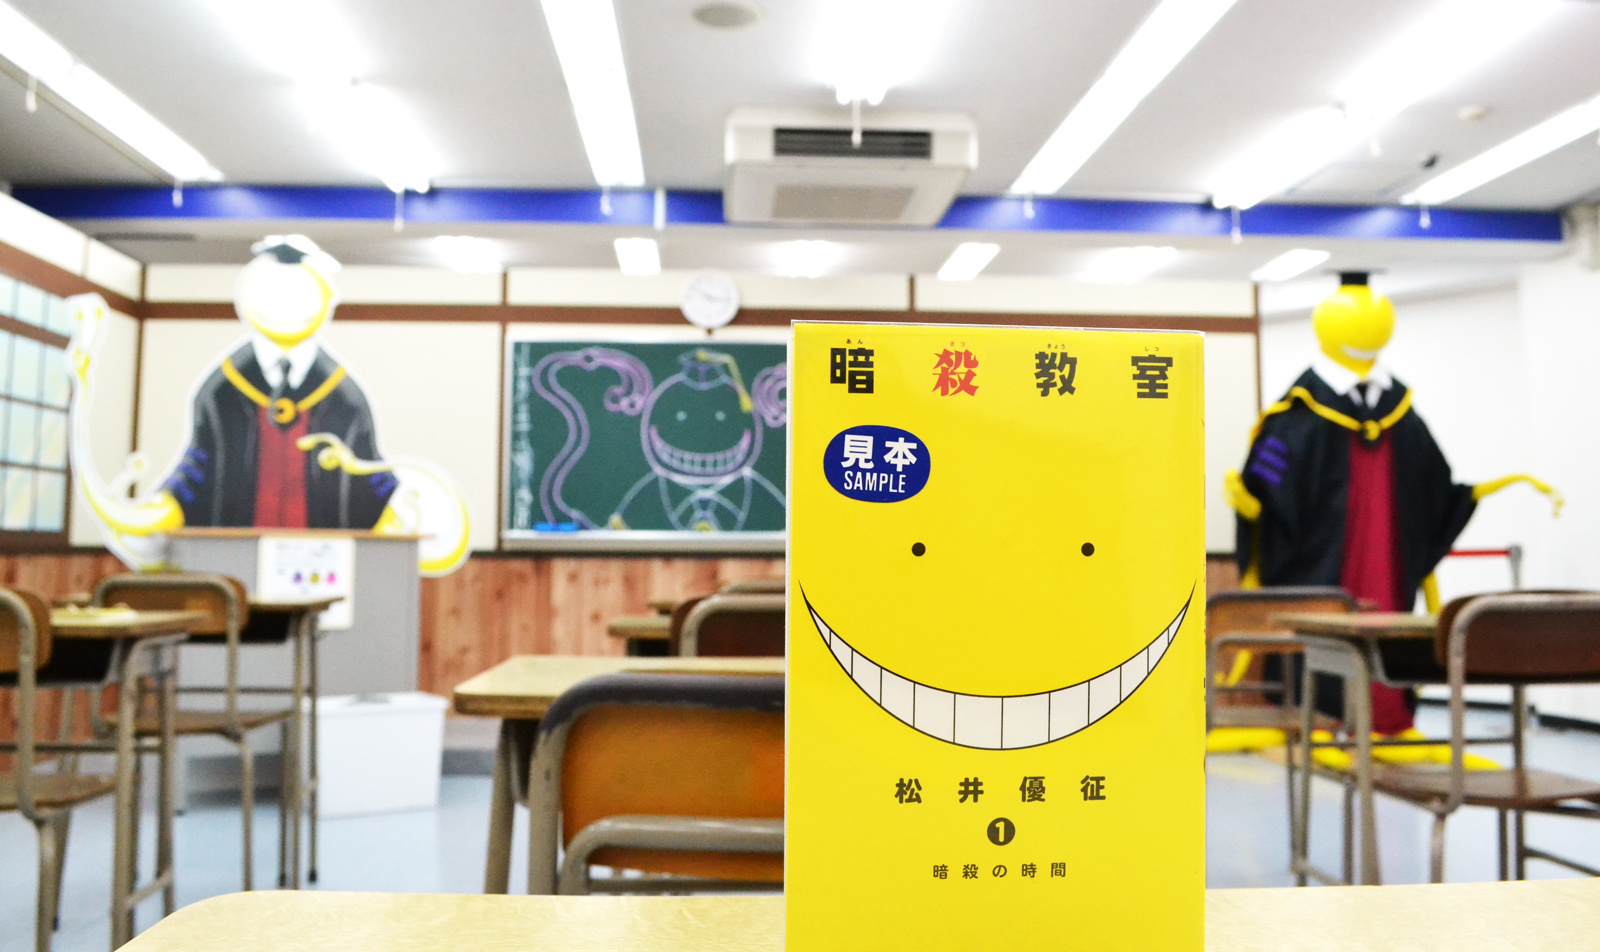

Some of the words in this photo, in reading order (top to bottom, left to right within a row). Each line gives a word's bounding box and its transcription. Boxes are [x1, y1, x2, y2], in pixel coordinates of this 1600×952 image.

[830, 347, 1174, 399] 暗殺教室
[840, 434, 918, 472] 見本
[843, 470, 907, 494] SAMPLE
[894, 775, 1107, 804] 松井優征
[932, 862, 1067, 879] 暗殺の時間
